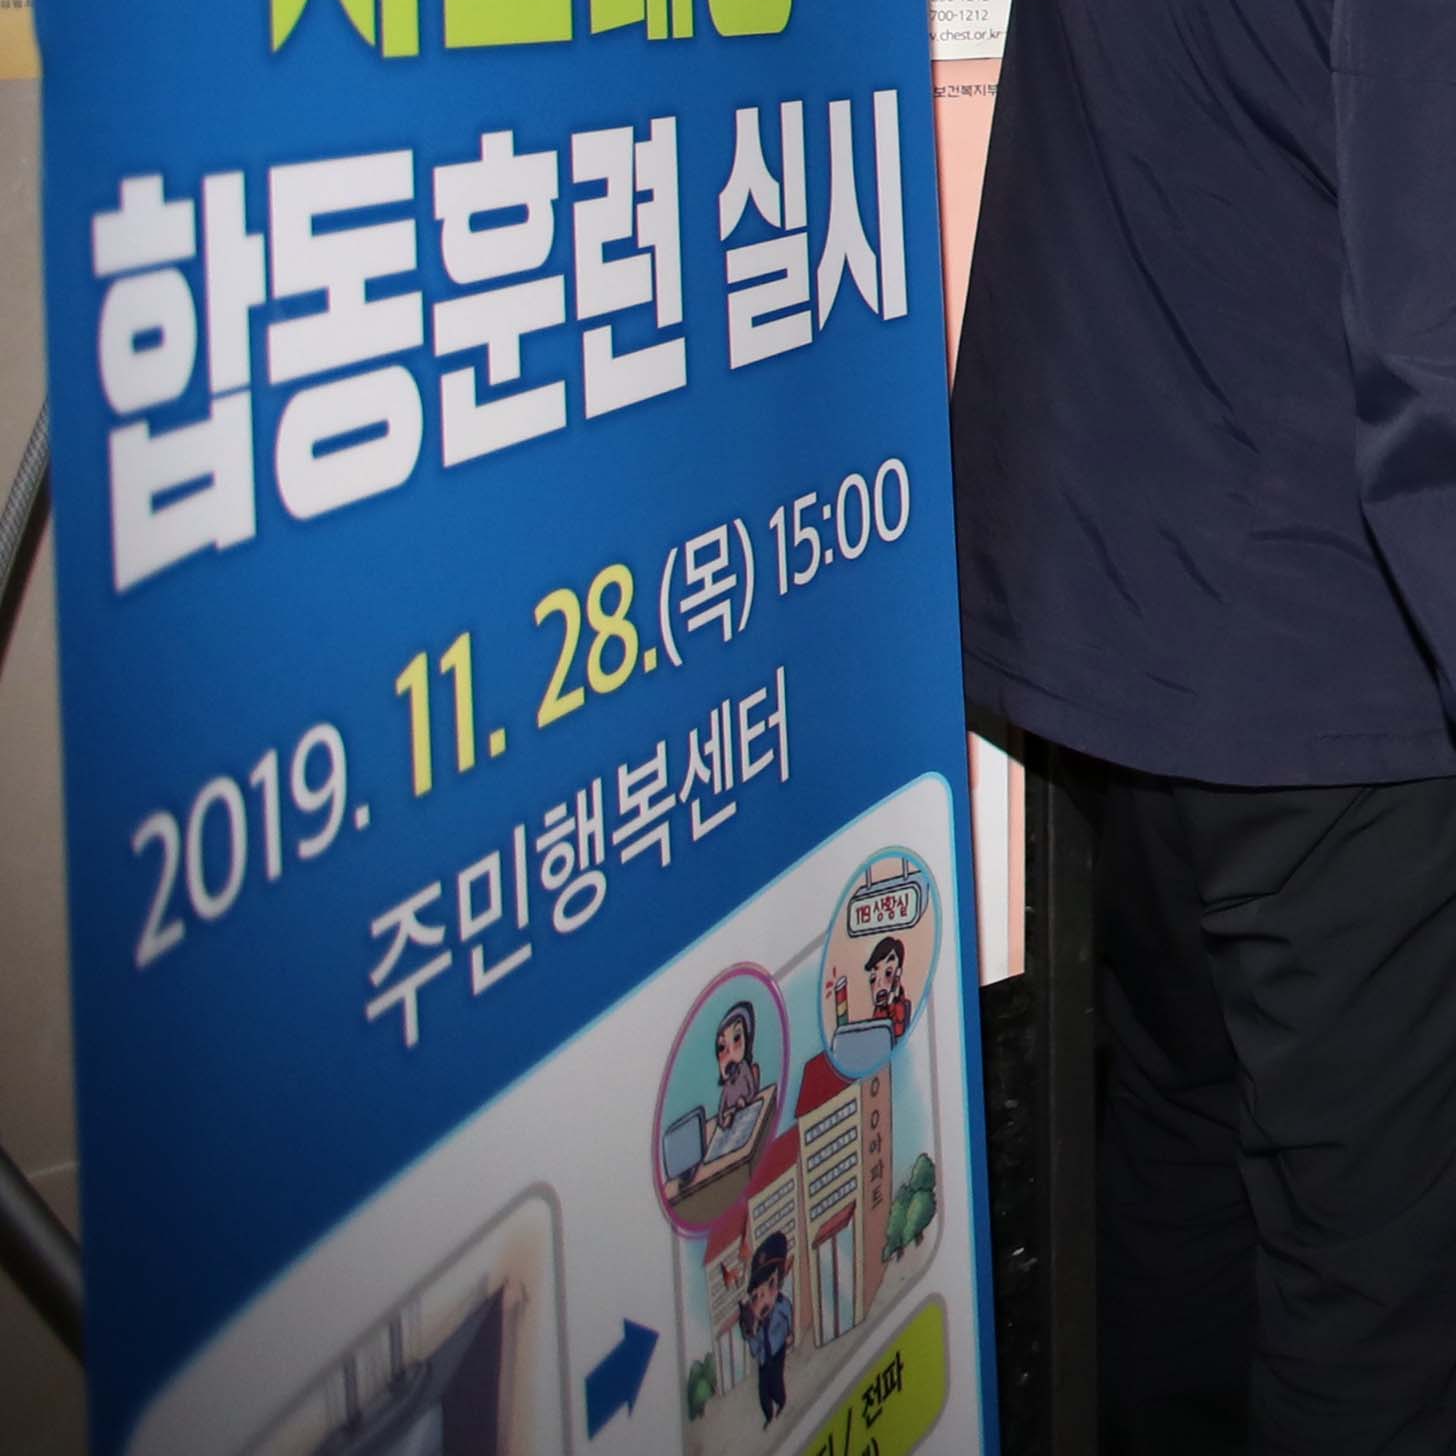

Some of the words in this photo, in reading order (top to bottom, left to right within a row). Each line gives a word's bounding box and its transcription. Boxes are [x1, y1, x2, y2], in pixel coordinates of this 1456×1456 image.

[91, 115, 687, 595] 합동훈련
[718, 89, 908, 372] 실시
[131, 722, 370, 970] 2019.
[393, 632, 507, 799] 11.
[769, 458, 911, 598] 15:00
[364, 666, 790, 1049] 주민행복센터
